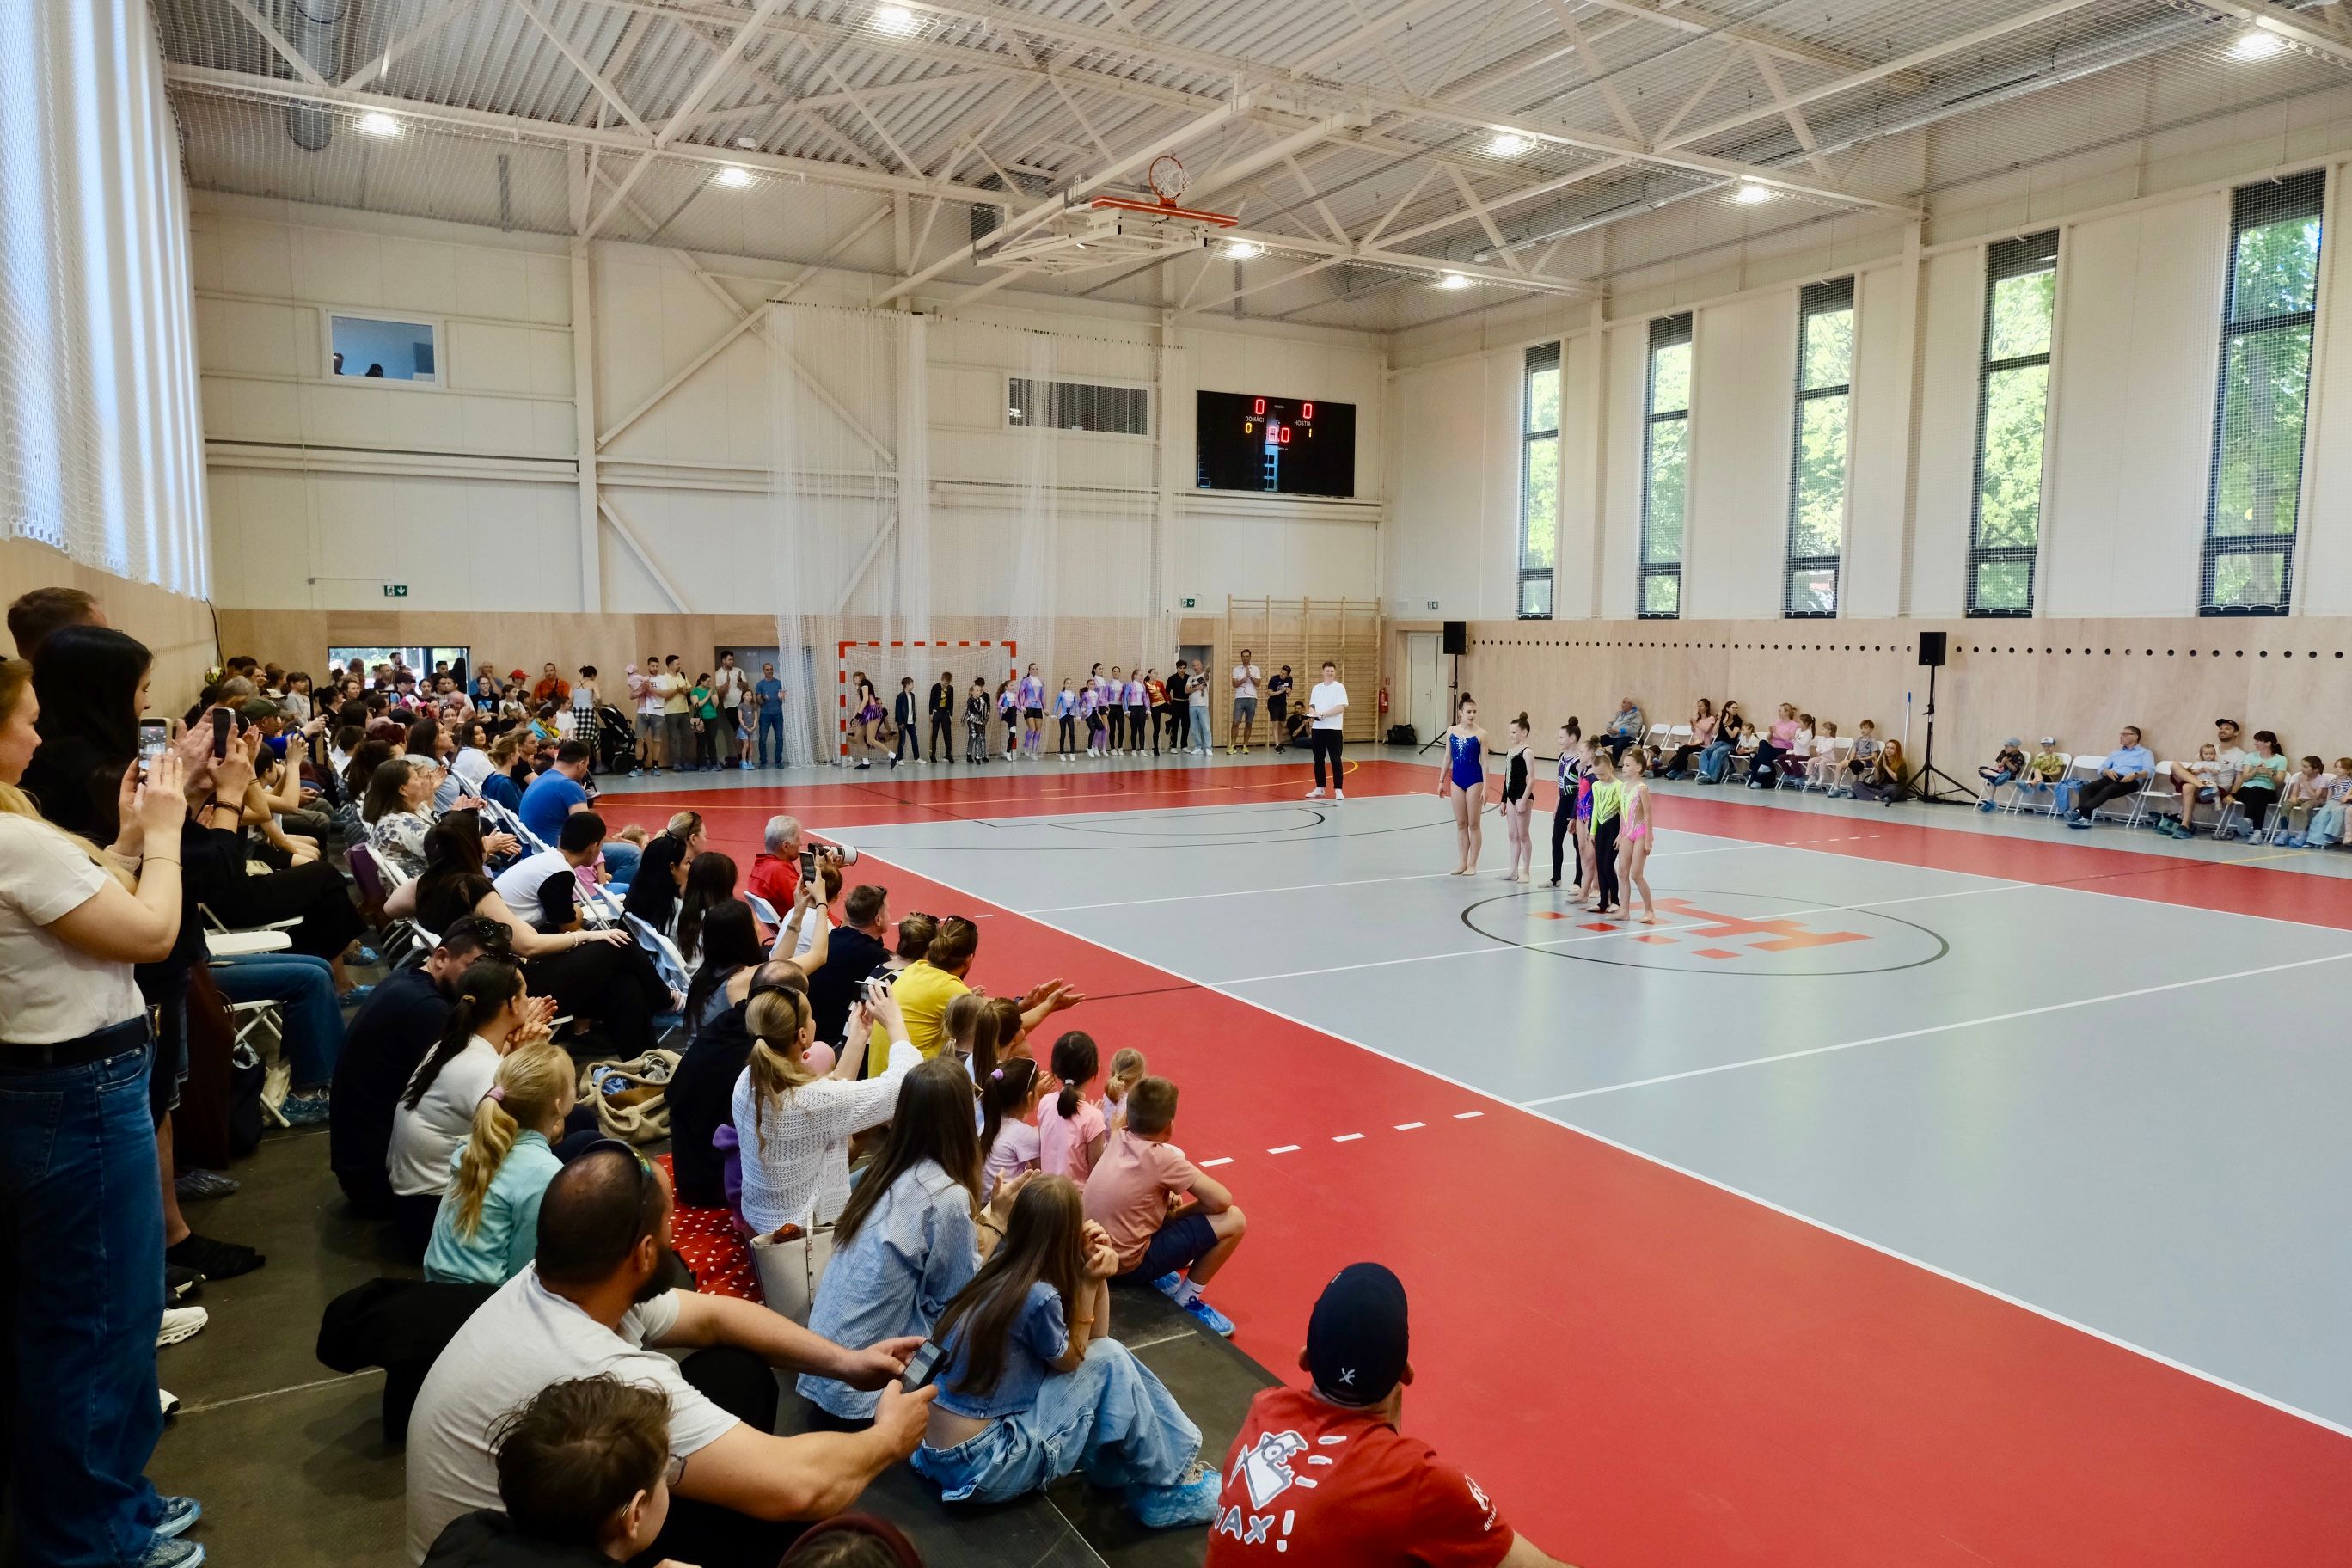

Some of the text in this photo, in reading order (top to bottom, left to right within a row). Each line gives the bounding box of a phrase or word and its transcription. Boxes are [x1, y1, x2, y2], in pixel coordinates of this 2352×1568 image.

[1255, 399, 1265, 414] 0
[1302, 403, 1313, 420] 0
[1245, 423, 1253, 433] 0
[1308, 428, 1313, 438] 1
